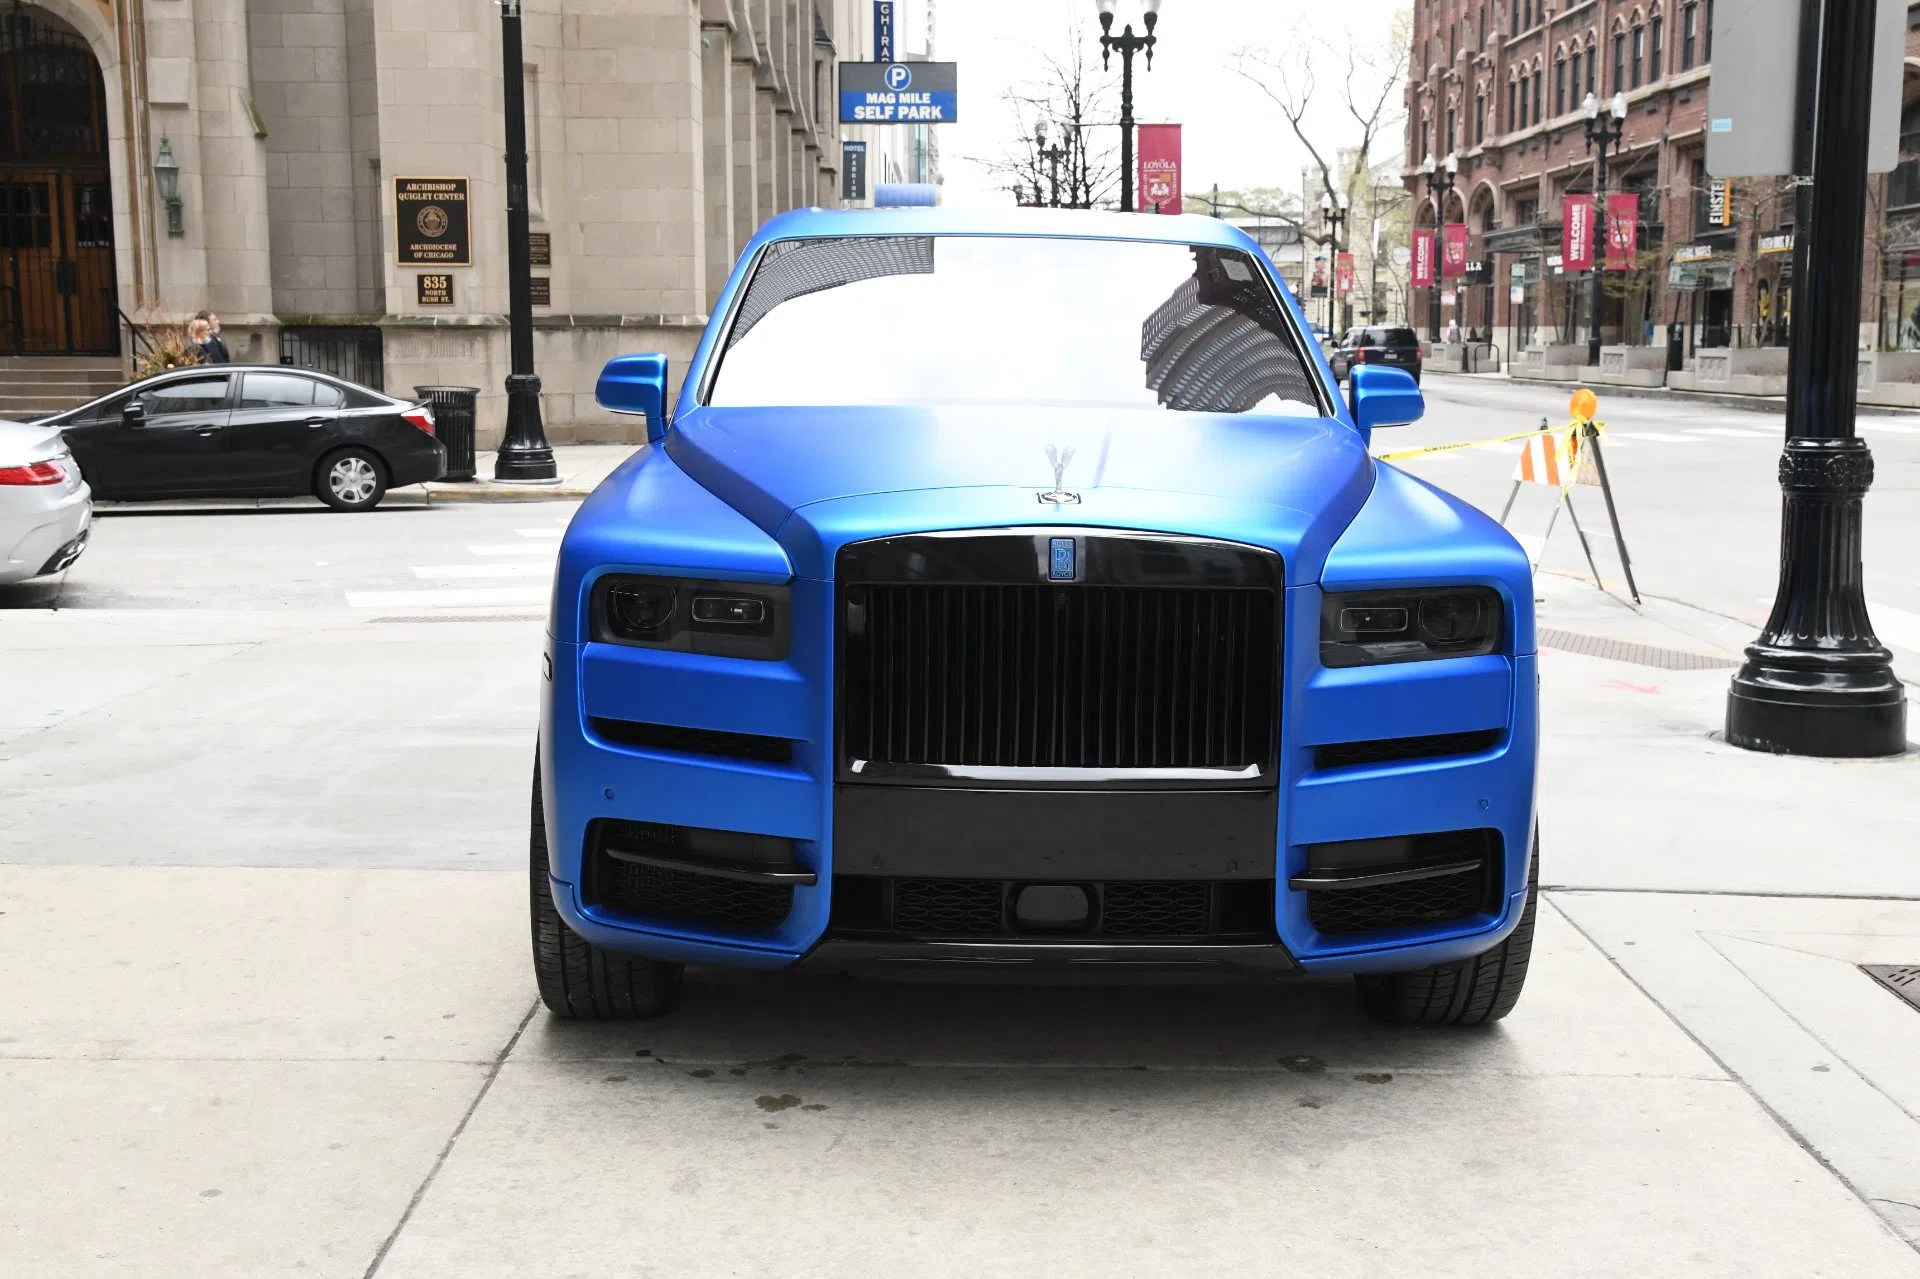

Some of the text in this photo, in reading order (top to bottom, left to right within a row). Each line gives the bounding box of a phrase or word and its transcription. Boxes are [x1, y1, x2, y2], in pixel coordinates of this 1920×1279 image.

[866, 93, 931, 104] MAG MILE
[854, 106, 942, 120] SELF PARK
[1144, 161, 1177, 169] LOYOLA
[406, 183, 456, 191] ARCHBISHOP
[398, 193, 432, 201] QUIGLEY
[1709, 175, 1725, 224] EINSTEI
[1570, 204, 1580, 261] WELCOME
[1416, 236, 1424, 280] WELCOME
[424, 276, 446, 289] 835
